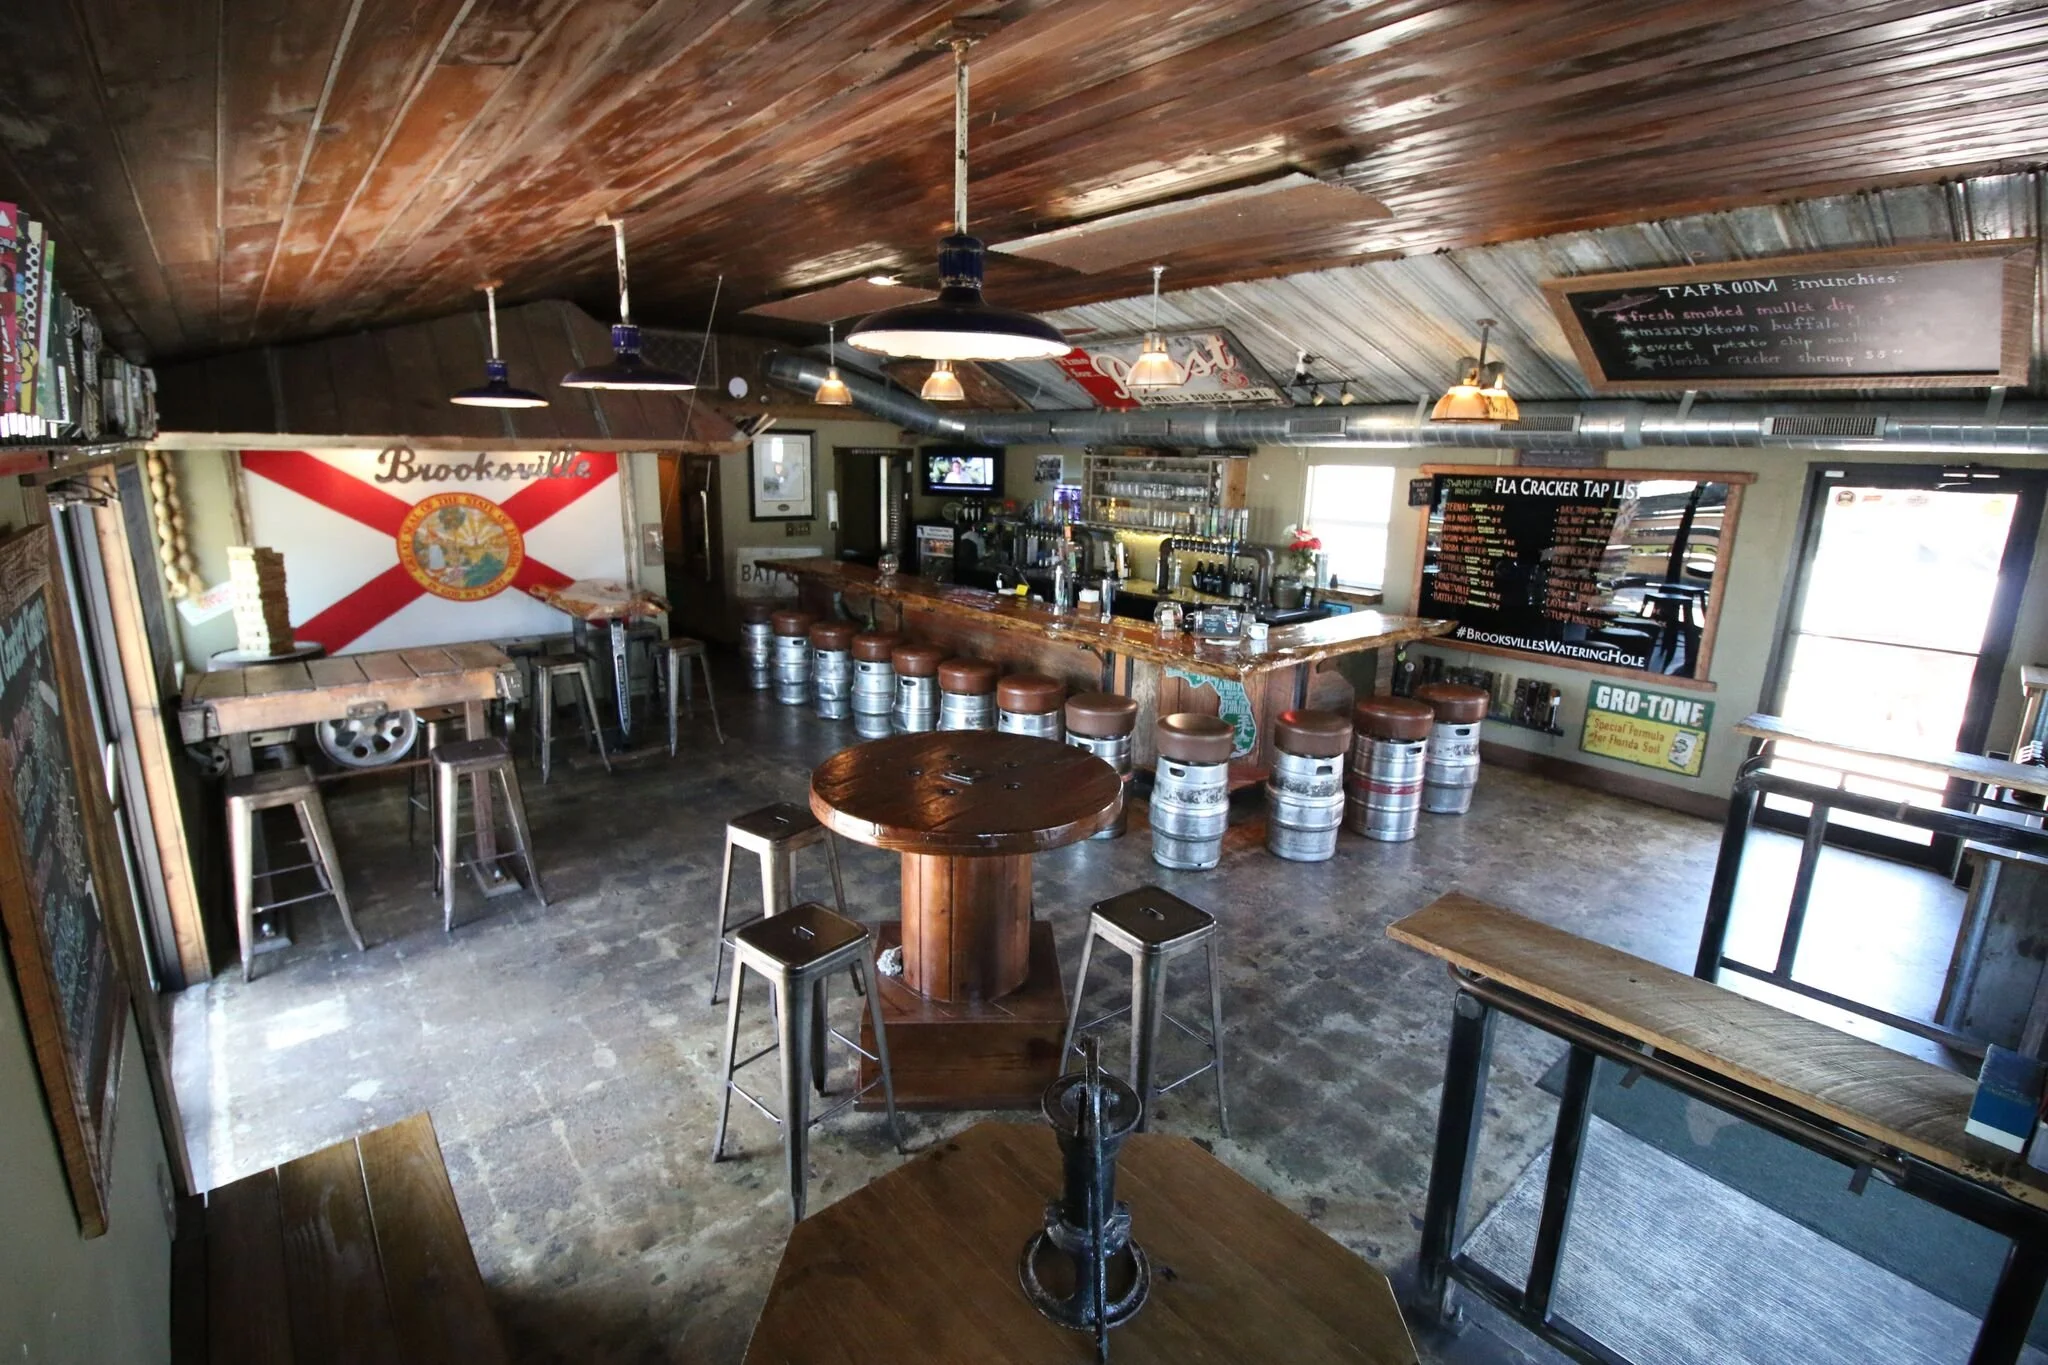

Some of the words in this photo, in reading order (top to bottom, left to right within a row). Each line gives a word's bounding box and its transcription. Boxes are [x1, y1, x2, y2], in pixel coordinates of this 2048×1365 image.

[1658, 279, 1779, 299] TAPROOM
[1800, 272, 1897, 289] munchies
[1630, 308, 1675, 322] fresh
[1682, 304, 1744, 320] smoked
[1756, 300, 1814, 315] mullet
[1826, 296, 1855, 315] dip
[1646, 340, 1694, 352] sweet
[1712, 338, 1767, 356] potato
[375, 444, 592, 484] Brooksville
[1494, 476, 1517, 495] FLA
[1520, 477, 1579, 497] CRACKER
[1583, 480, 1610, 498] TAP
[1596, 685, 1705, 727] GRO-TONE
[1594, 718, 1626, 734] Special
[1629, 723, 1665, 742] Formula
[1642, 740, 1661, 755] Soil
